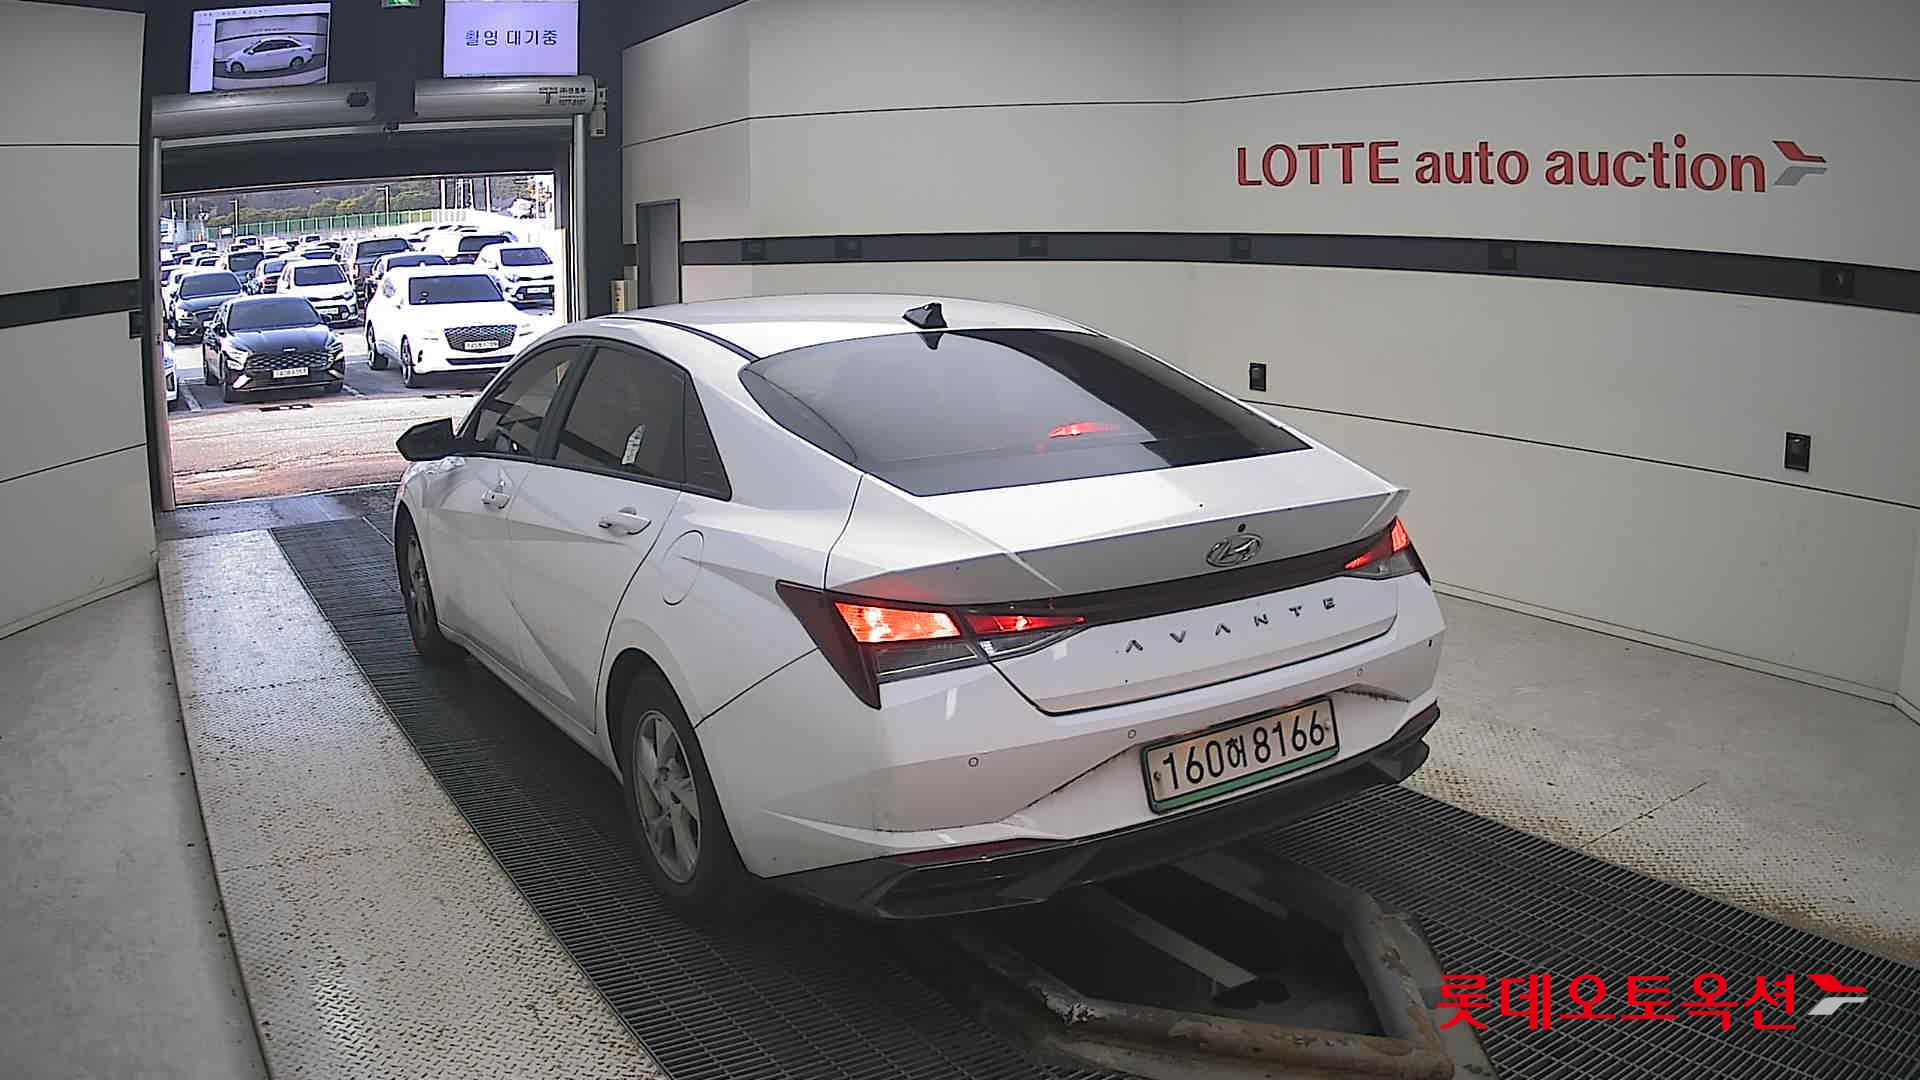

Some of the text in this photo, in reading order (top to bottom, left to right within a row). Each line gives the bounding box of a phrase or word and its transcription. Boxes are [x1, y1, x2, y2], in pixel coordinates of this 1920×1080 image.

[506, 30, 558, 46] 대기중
[1237, 134, 1766, 192] LOTTE auto auction
[1125, 597, 1336, 654] AVANTE
